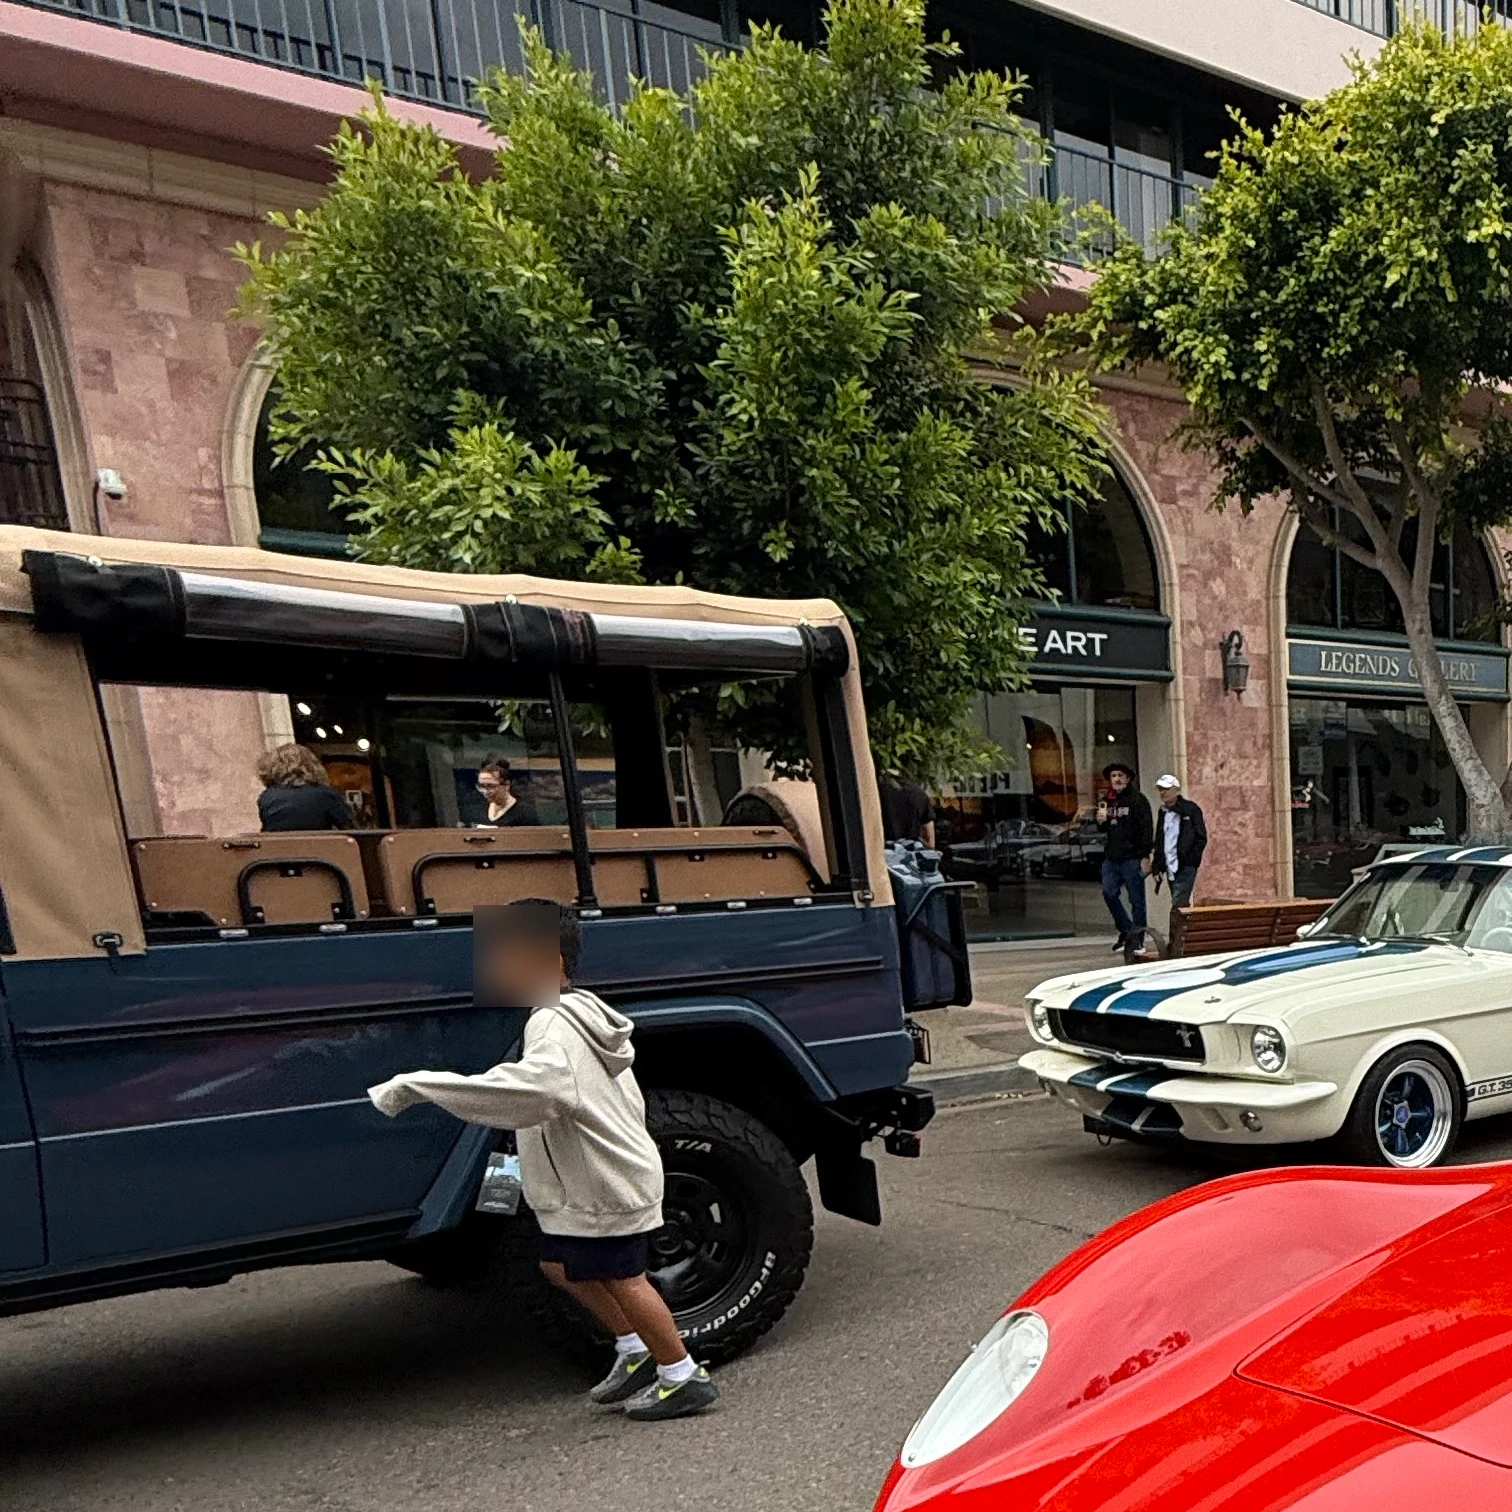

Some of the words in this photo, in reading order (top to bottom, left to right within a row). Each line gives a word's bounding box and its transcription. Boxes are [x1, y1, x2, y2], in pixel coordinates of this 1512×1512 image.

[1043, 629, 1108, 656] ART
[1319, 650, 1400, 678] LEGENDS
[1408, 658, 1481, 682] GLERY
[674, 1138, 713, 1154] T/A
[676, 1250, 777, 1339] BFGoodric
